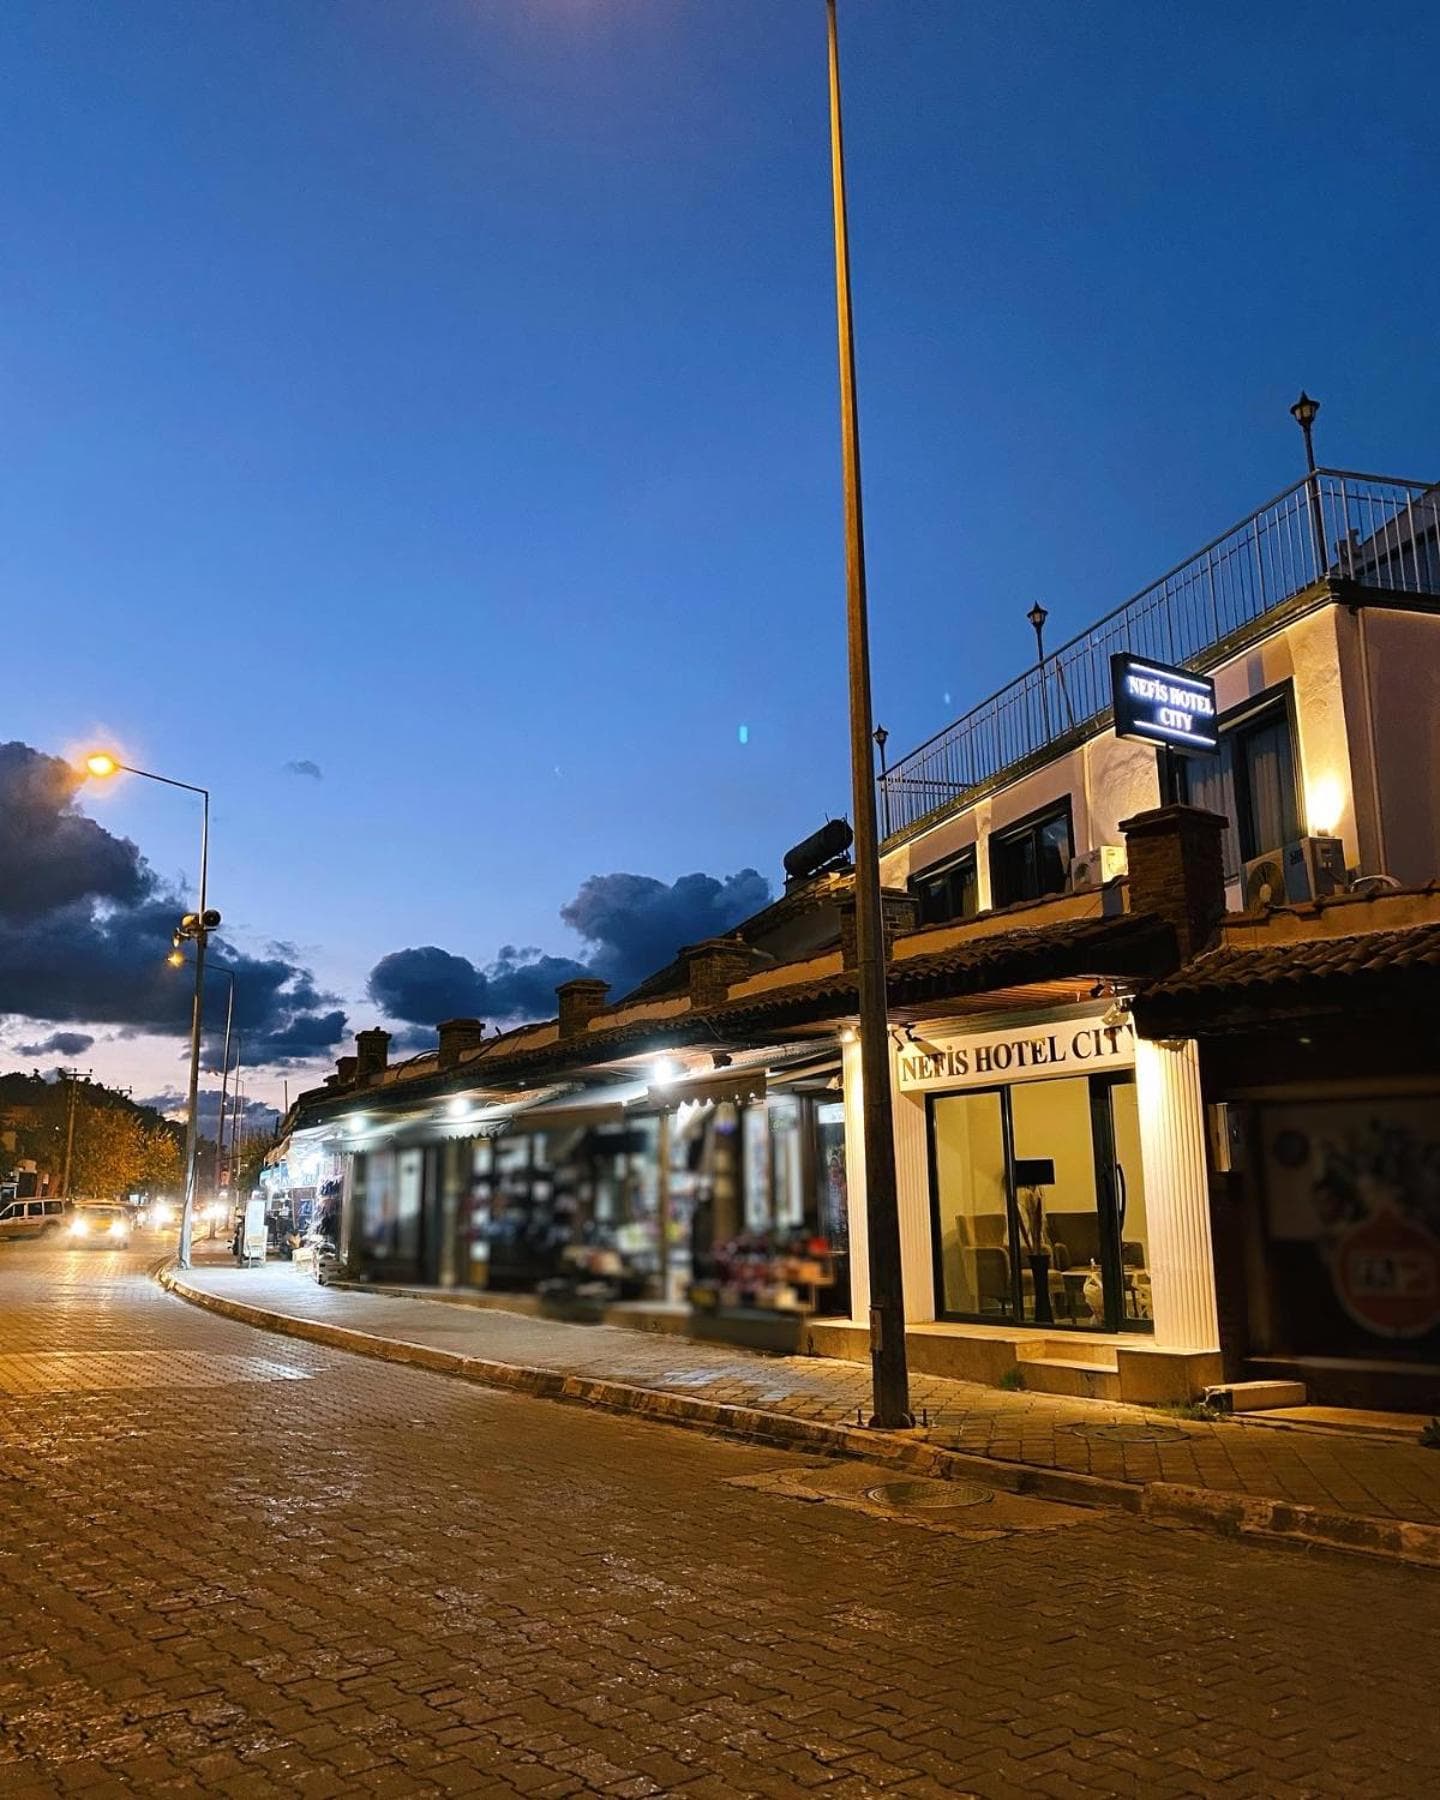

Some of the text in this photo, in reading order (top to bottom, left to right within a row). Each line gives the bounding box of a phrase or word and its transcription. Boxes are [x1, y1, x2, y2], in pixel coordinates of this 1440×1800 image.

[1169, 687, 1215, 715] HOTEL
[1160, 707, 1193, 731] CITY
[975, 1036, 1066, 1073] HOTEL
